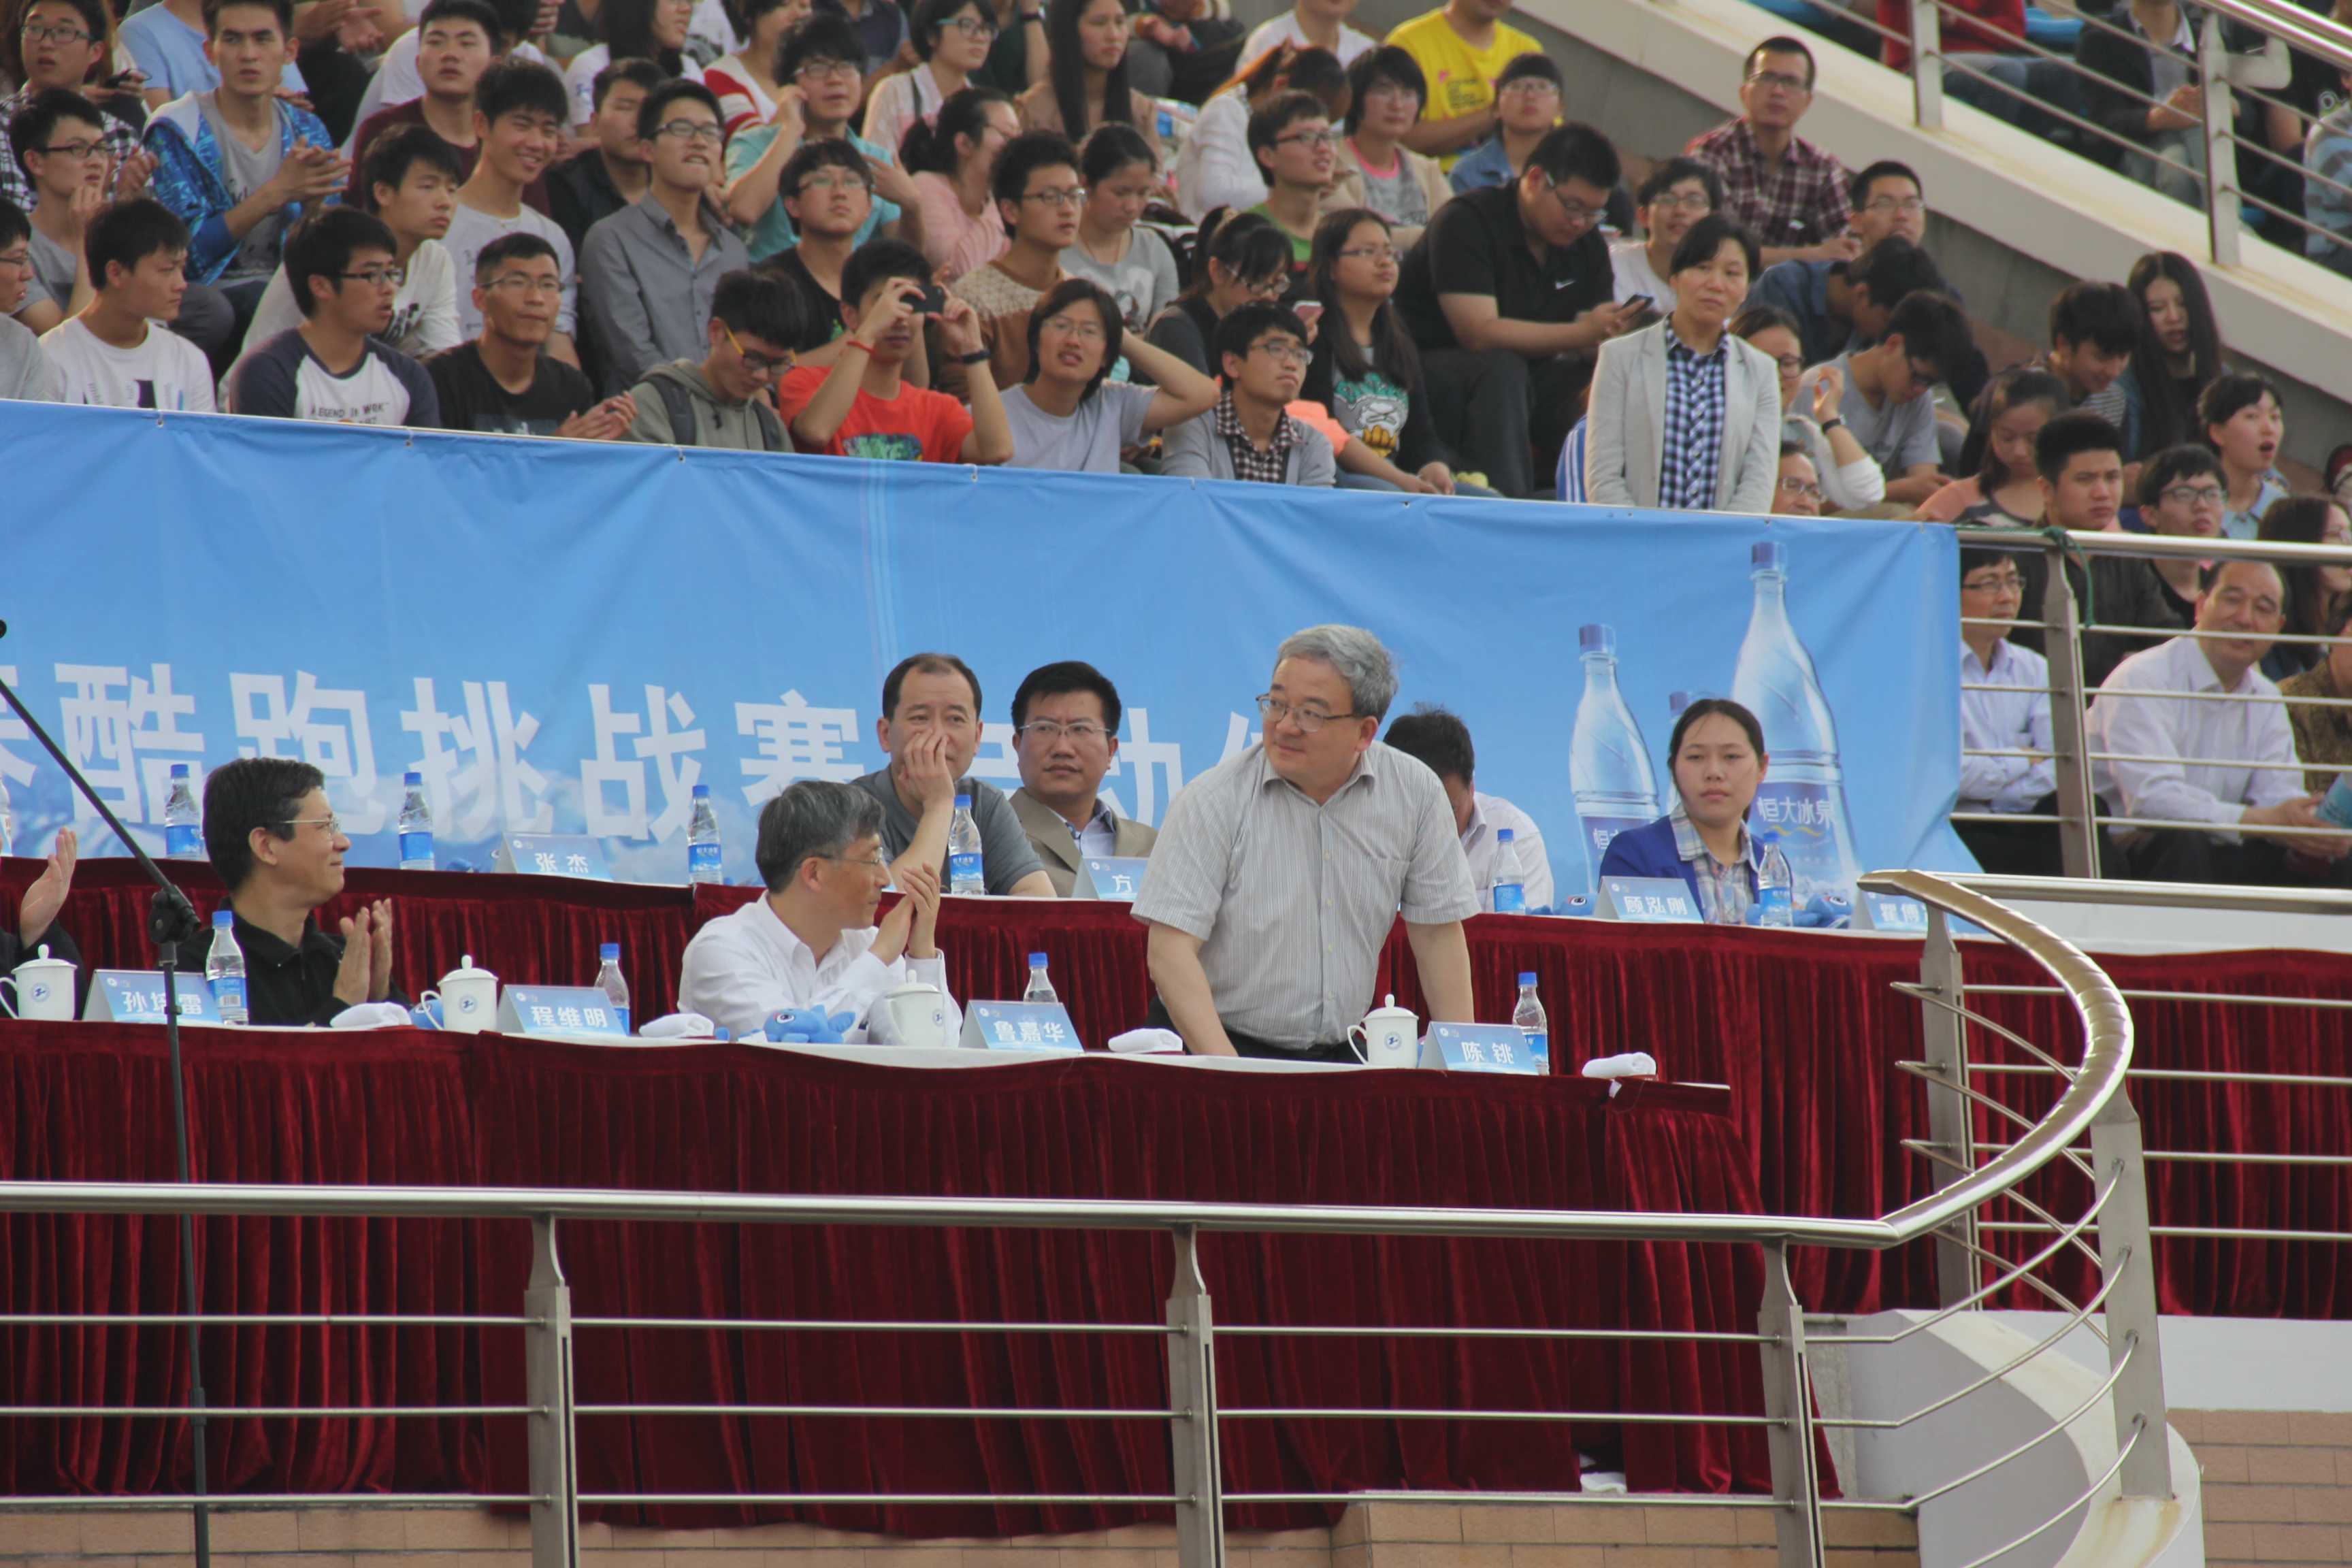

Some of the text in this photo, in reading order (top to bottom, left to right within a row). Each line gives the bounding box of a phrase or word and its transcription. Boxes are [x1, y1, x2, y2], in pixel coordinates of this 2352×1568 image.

[1757, 796, 1832, 830] 恒大冰泉
[534, 853, 589, 874] 张杰
[1111, 875, 1132, 893] 方
[530, 1005, 608, 1028] 程维明
[994, 1020, 1066, 1043] 鲁嘉华
